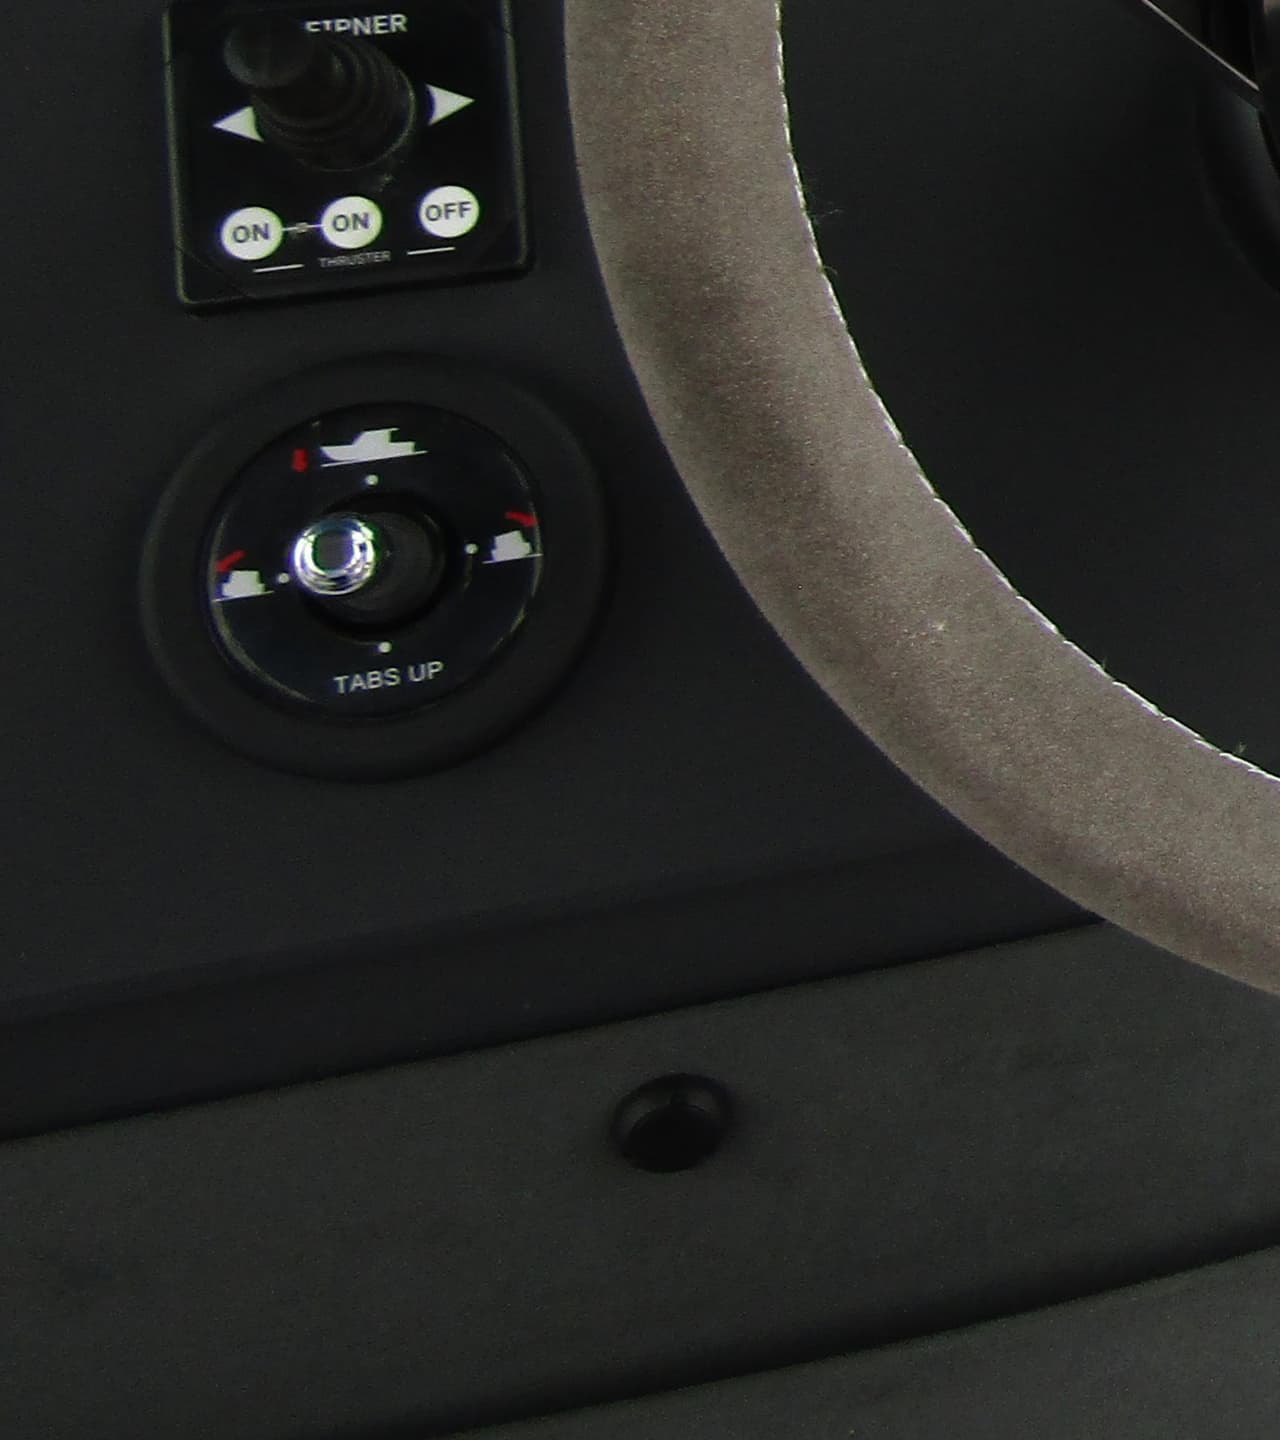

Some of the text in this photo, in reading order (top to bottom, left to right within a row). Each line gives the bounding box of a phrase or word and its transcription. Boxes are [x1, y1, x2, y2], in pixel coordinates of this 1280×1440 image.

[332, 212, 370, 233] ON
[424, 200, 473, 223] OFF
[232, 222, 270, 244] ON
[318, 250, 391, 268] THRUSTER
[334, 660, 444, 695] TABS UP
